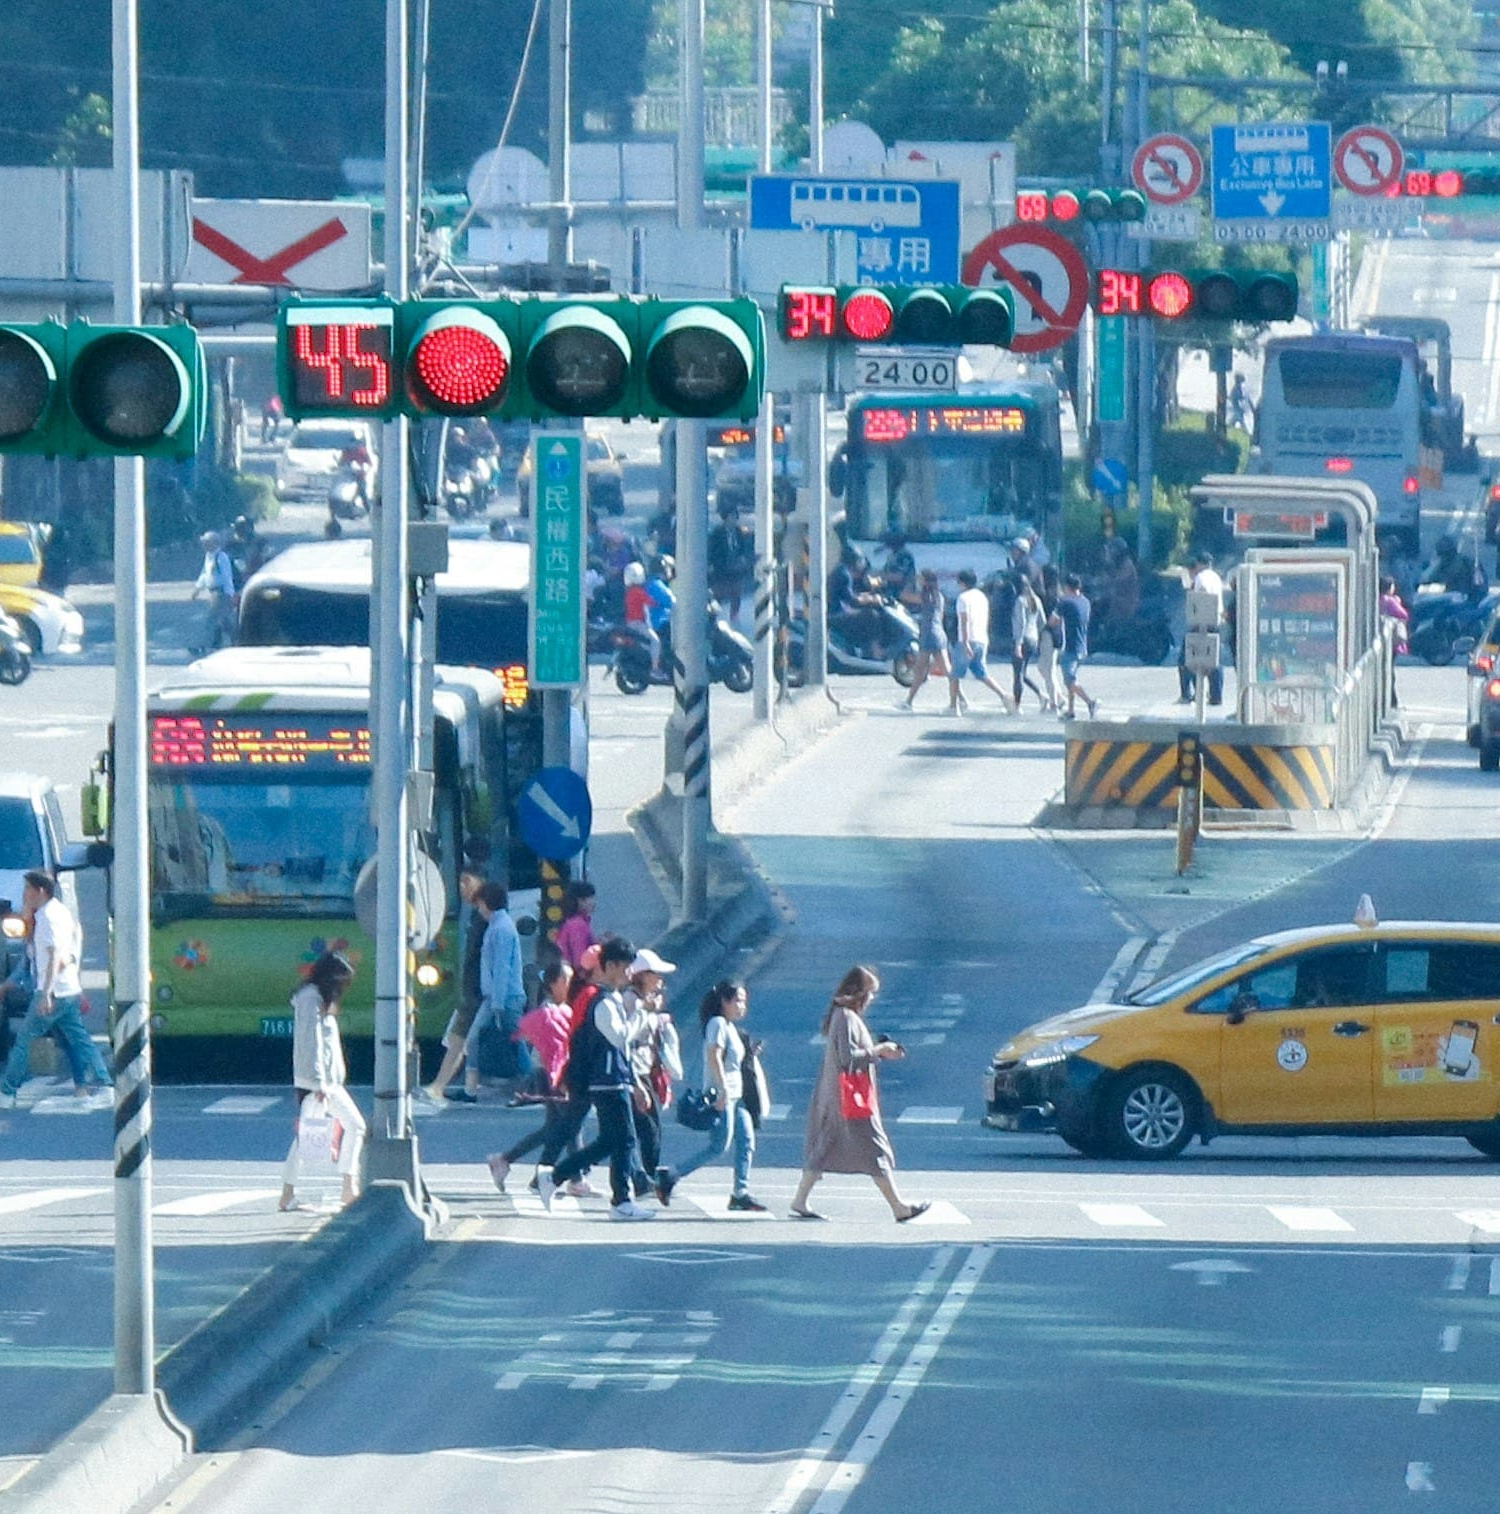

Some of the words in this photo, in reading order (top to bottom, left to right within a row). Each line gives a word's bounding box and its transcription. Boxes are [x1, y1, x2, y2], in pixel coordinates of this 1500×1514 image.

[860, 237, 931, 273] 專用
[1100, 269, 1141, 314] 34
[789, 292, 835, 338] 34
[295, 324, 388, 405] 45
[865, 362, 949, 384] 24:00
